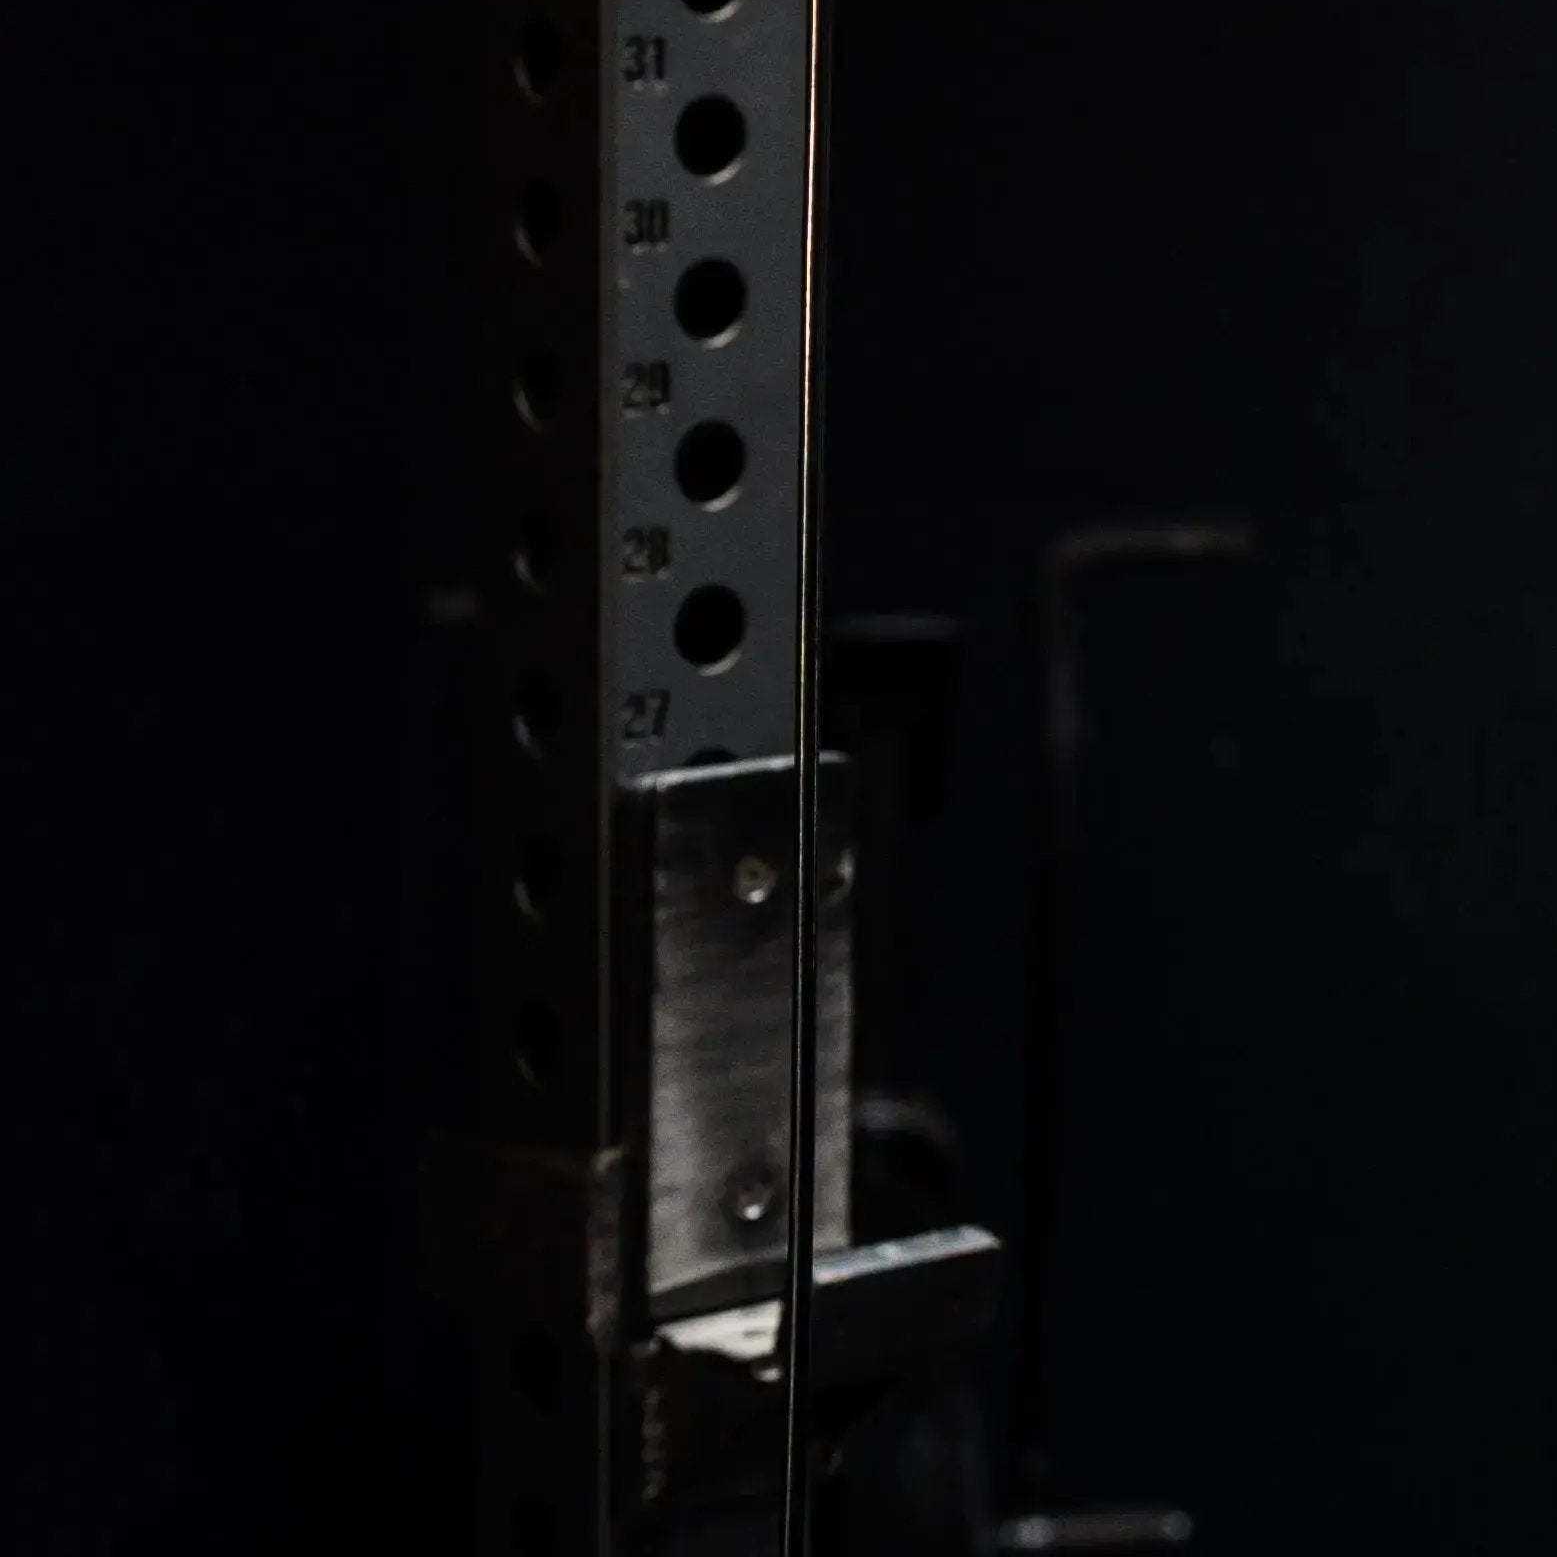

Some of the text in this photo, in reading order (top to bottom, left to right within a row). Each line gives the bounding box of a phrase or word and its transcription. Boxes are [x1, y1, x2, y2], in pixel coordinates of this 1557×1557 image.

[623, 35, 667, 84] 31
[623, 199, 670, 249] 30
[622, 688, 671, 739] 27
